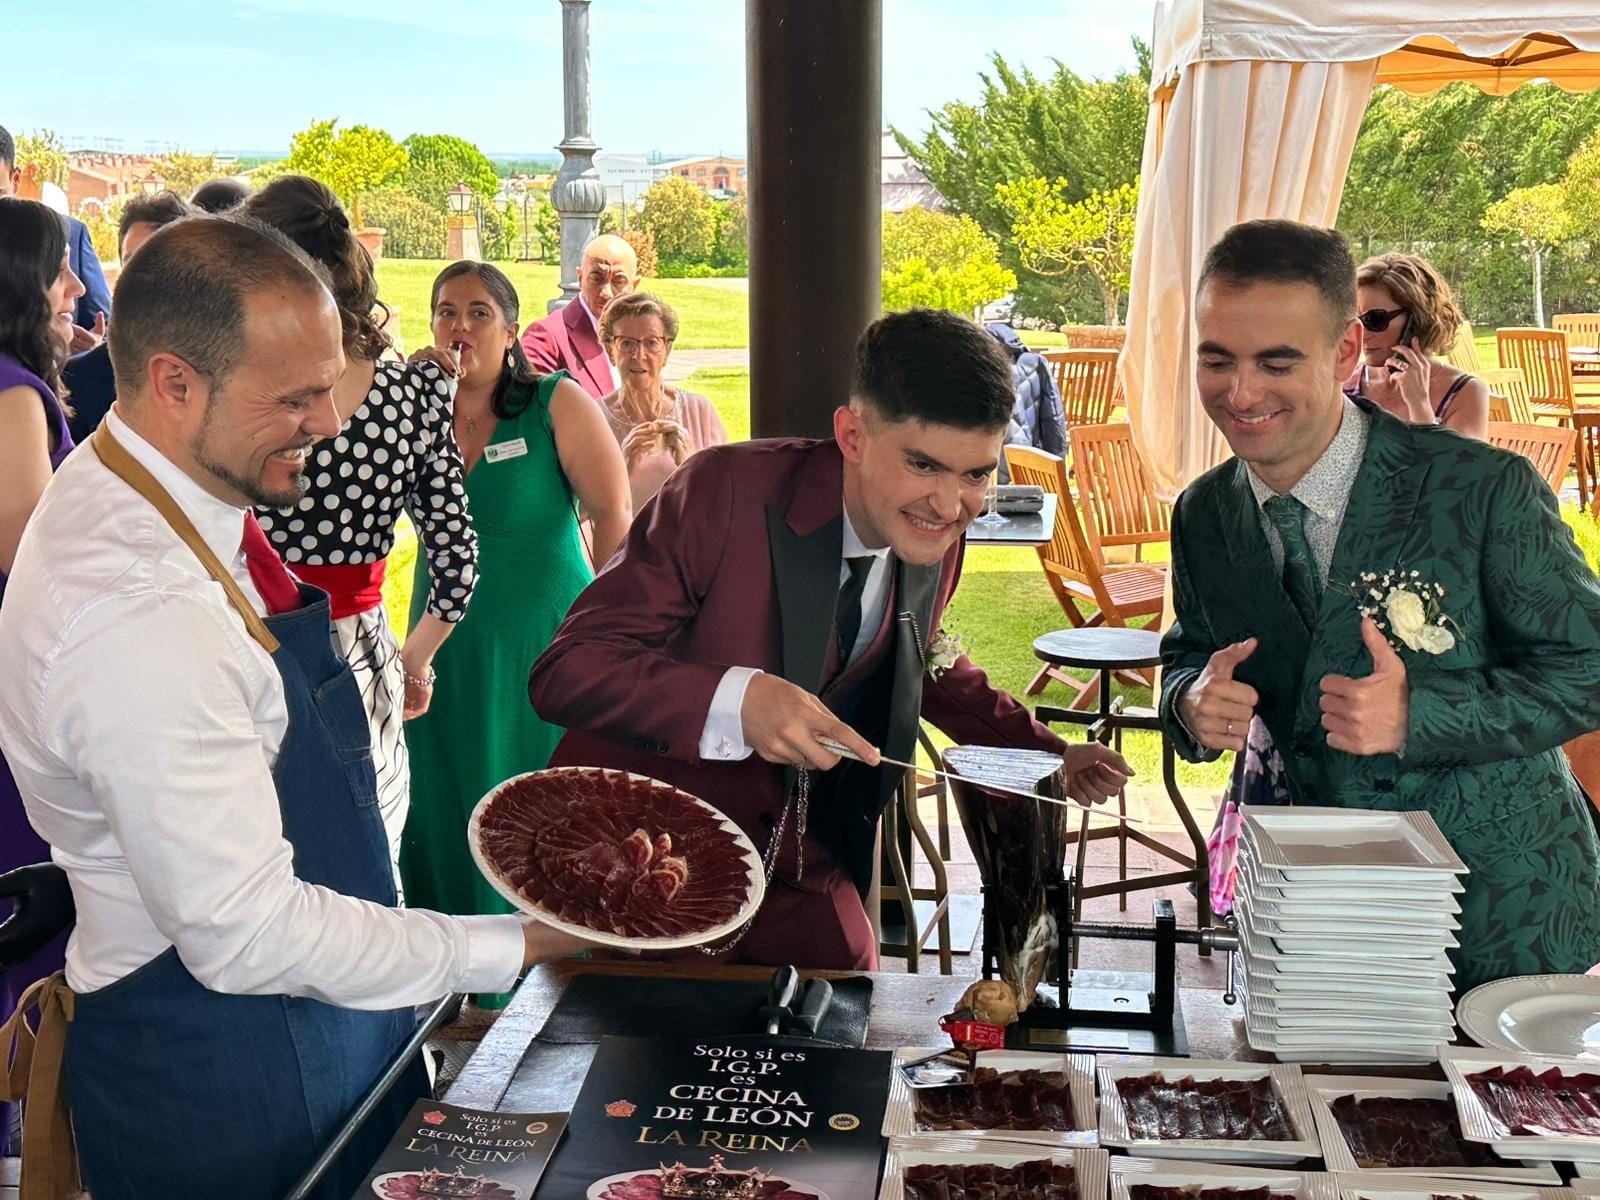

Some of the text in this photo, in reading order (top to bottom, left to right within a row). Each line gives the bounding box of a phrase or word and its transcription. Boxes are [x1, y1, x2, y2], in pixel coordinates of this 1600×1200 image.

[693, 1044, 806, 1062] Solo si es
[708, 1059, 781, 1076] I.G.P.
[730, 1075, 756, 1085] es
[669, 1084, 808, 1107] CECINA
[460, 1113, 488, 1124] Solo
[490, 1116, 502, 1125] si
[652, 1105, 815, 1128] DE LEÓN
[417, 1128, 538, 1148] CECINA DE LEÓN
[635, 1126, 816, 1154] LA REINA
[405, 1138, 529, 1165] LA REINA
